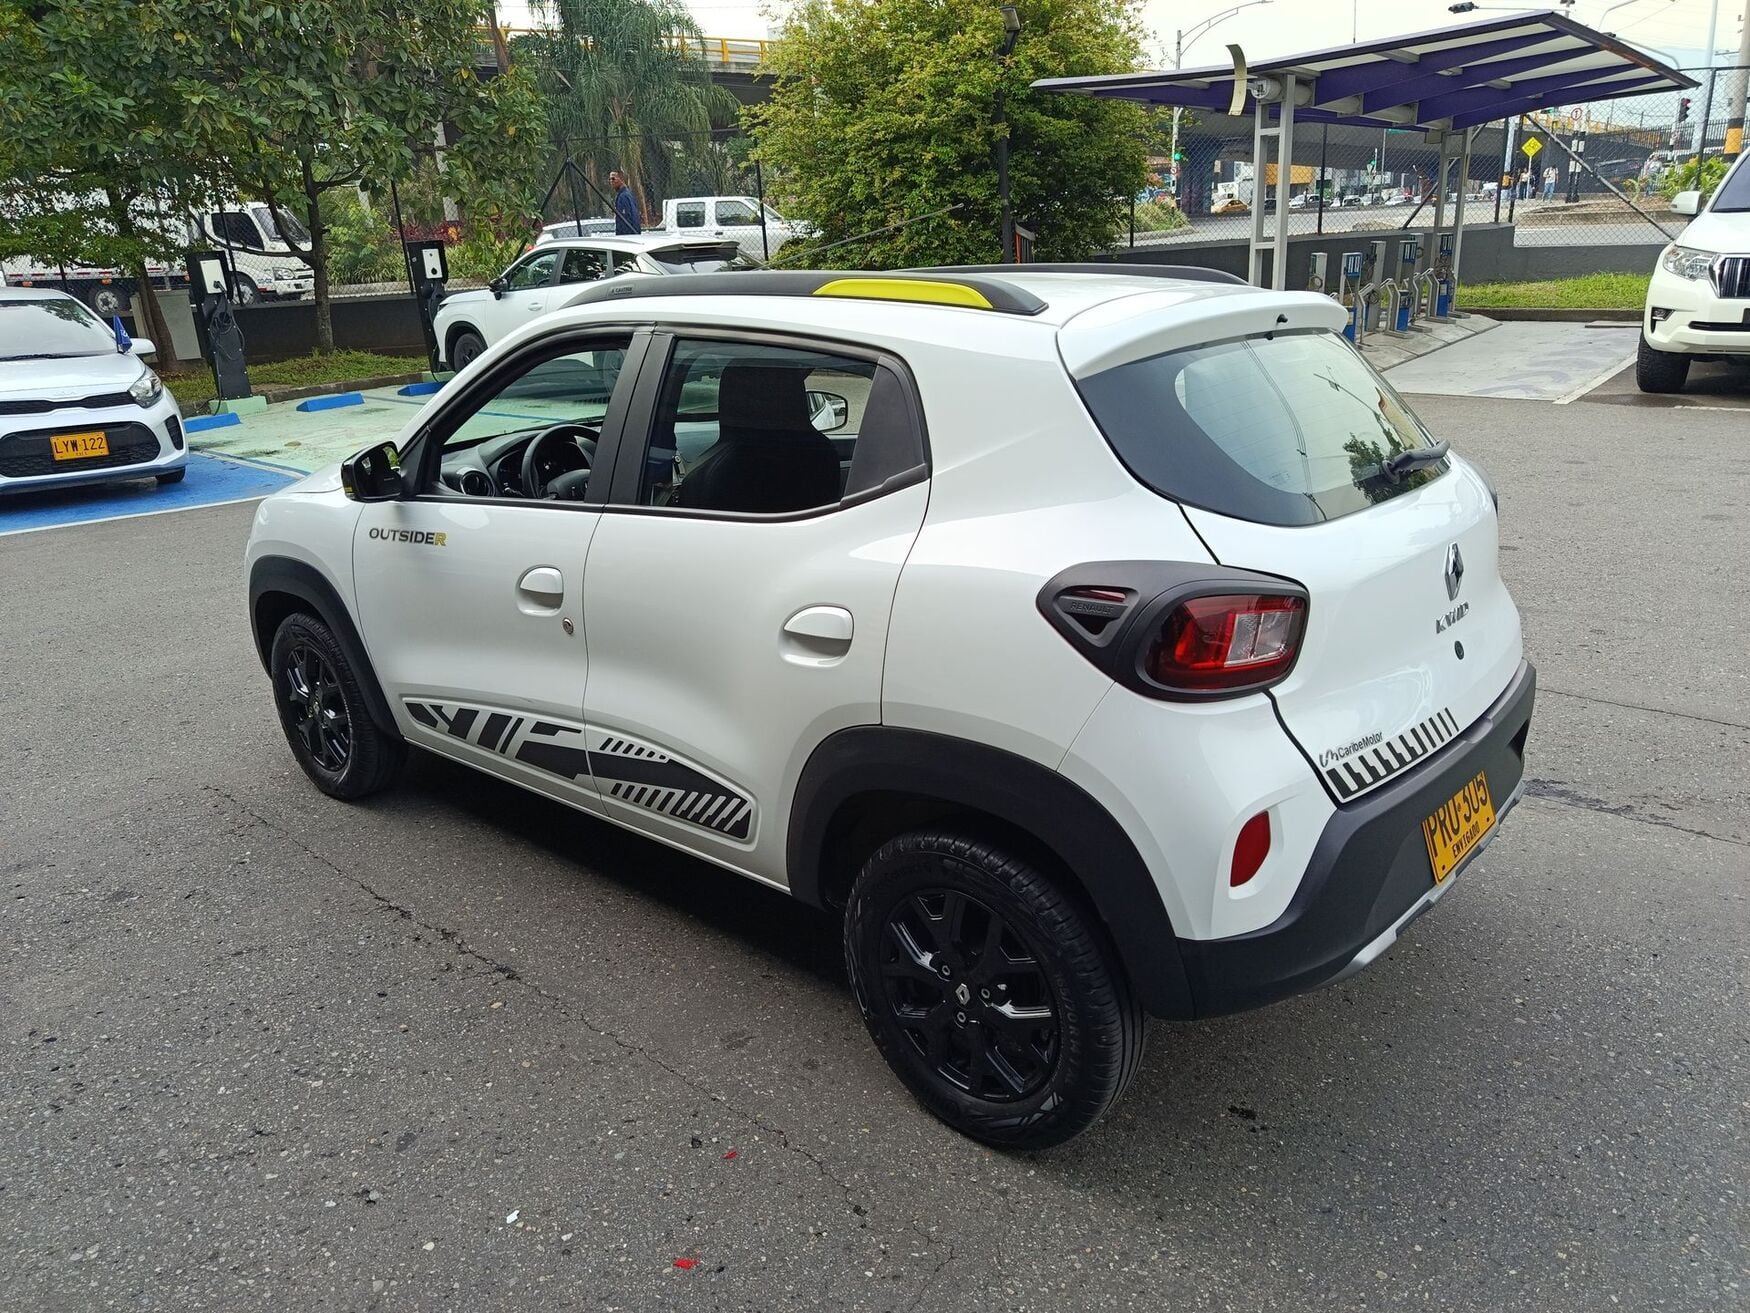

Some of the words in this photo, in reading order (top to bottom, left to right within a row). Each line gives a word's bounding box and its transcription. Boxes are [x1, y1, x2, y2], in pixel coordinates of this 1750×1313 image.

[54, 439, 78, 454] LYW
[81, 437, 105, 451] 122
[369, 528, 447, 547] OUTSIDER
[1070, 601, 1114, 615] RENAULT
[1436, 602, 1469, 634] KWID
[1338, 732, 1383, 758] CaribeMotor
[1452, 820, 1481, 858] ENVIGADO
